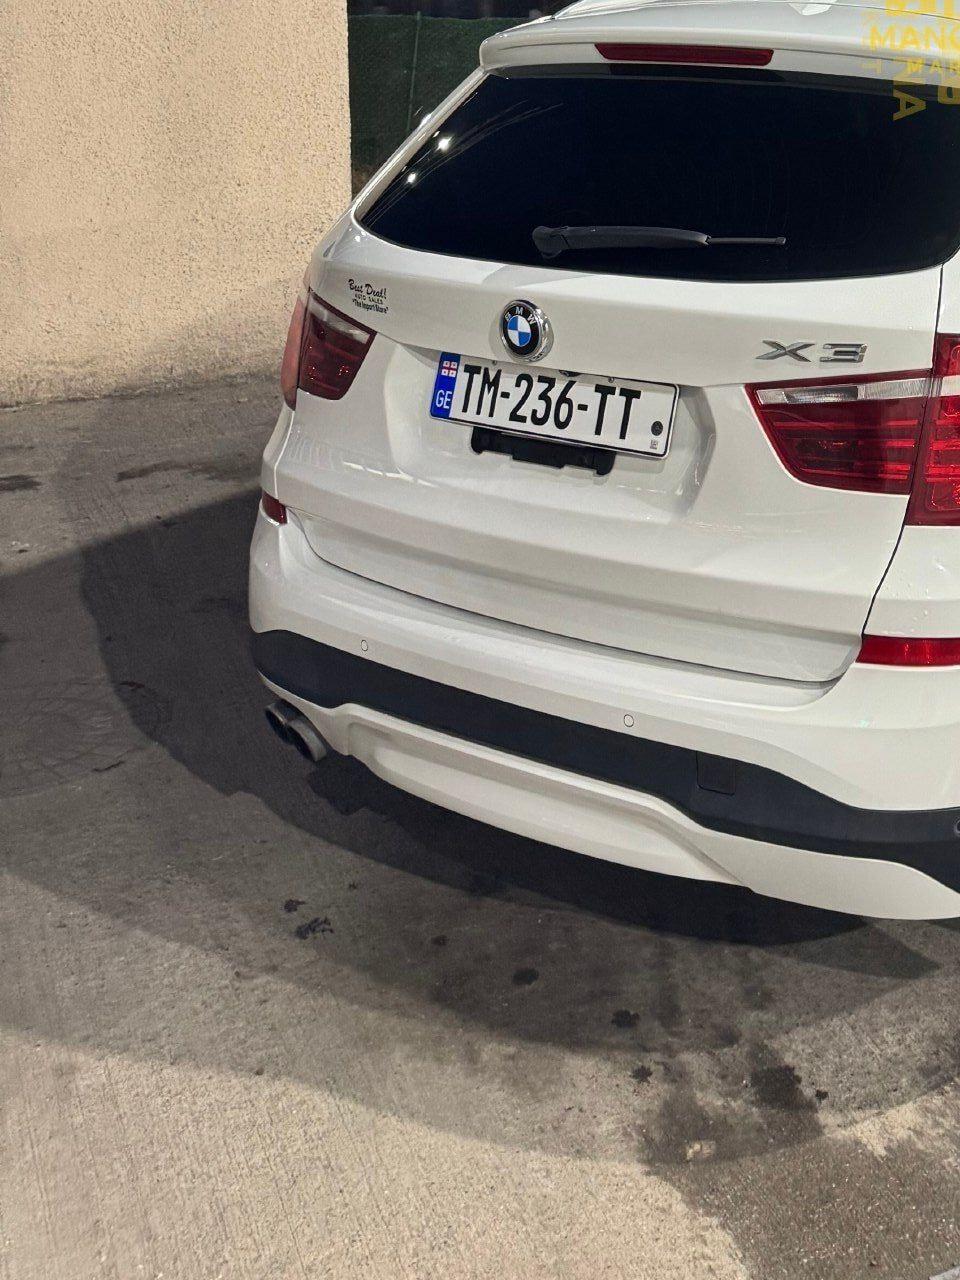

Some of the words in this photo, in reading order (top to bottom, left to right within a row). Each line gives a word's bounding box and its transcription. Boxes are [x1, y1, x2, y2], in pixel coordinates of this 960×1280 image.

[755, 340, 868, 363] X3
[436, 389, 453, 410] GE
[462, 363, 642, 439] TM-236-TT
